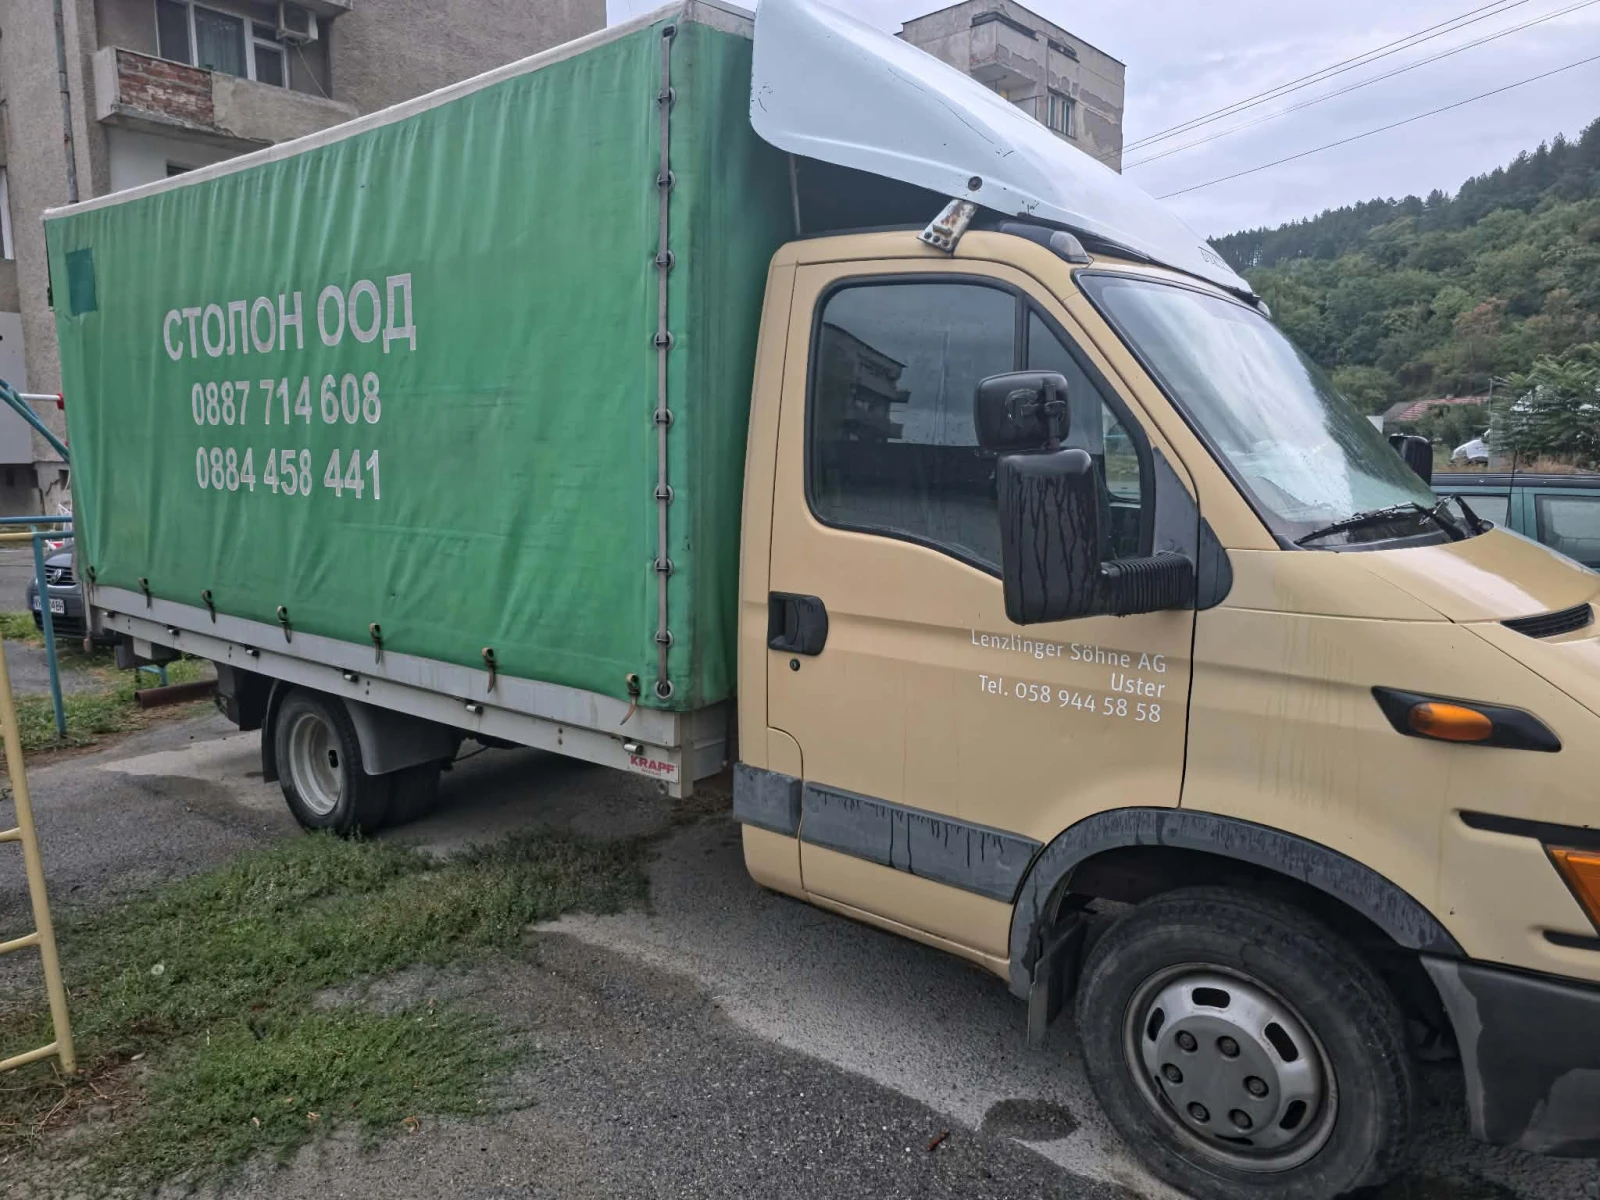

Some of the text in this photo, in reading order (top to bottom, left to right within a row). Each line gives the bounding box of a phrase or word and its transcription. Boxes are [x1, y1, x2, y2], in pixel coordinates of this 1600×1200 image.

[163, 273, 417, 361] СТОЛОН ООД
[191, 371, 381, 426] 0887 714 608
[196, 446, 380, 500] 0884 458 441
[971, 629, 1167, 673] Lenzlinger Söhne AG
[978, 674, 1161, 723] Tel. 058 944 58 58
[1111, 672, 1165, 698] Uster
[630, 755, 675, 773] KRAPF
